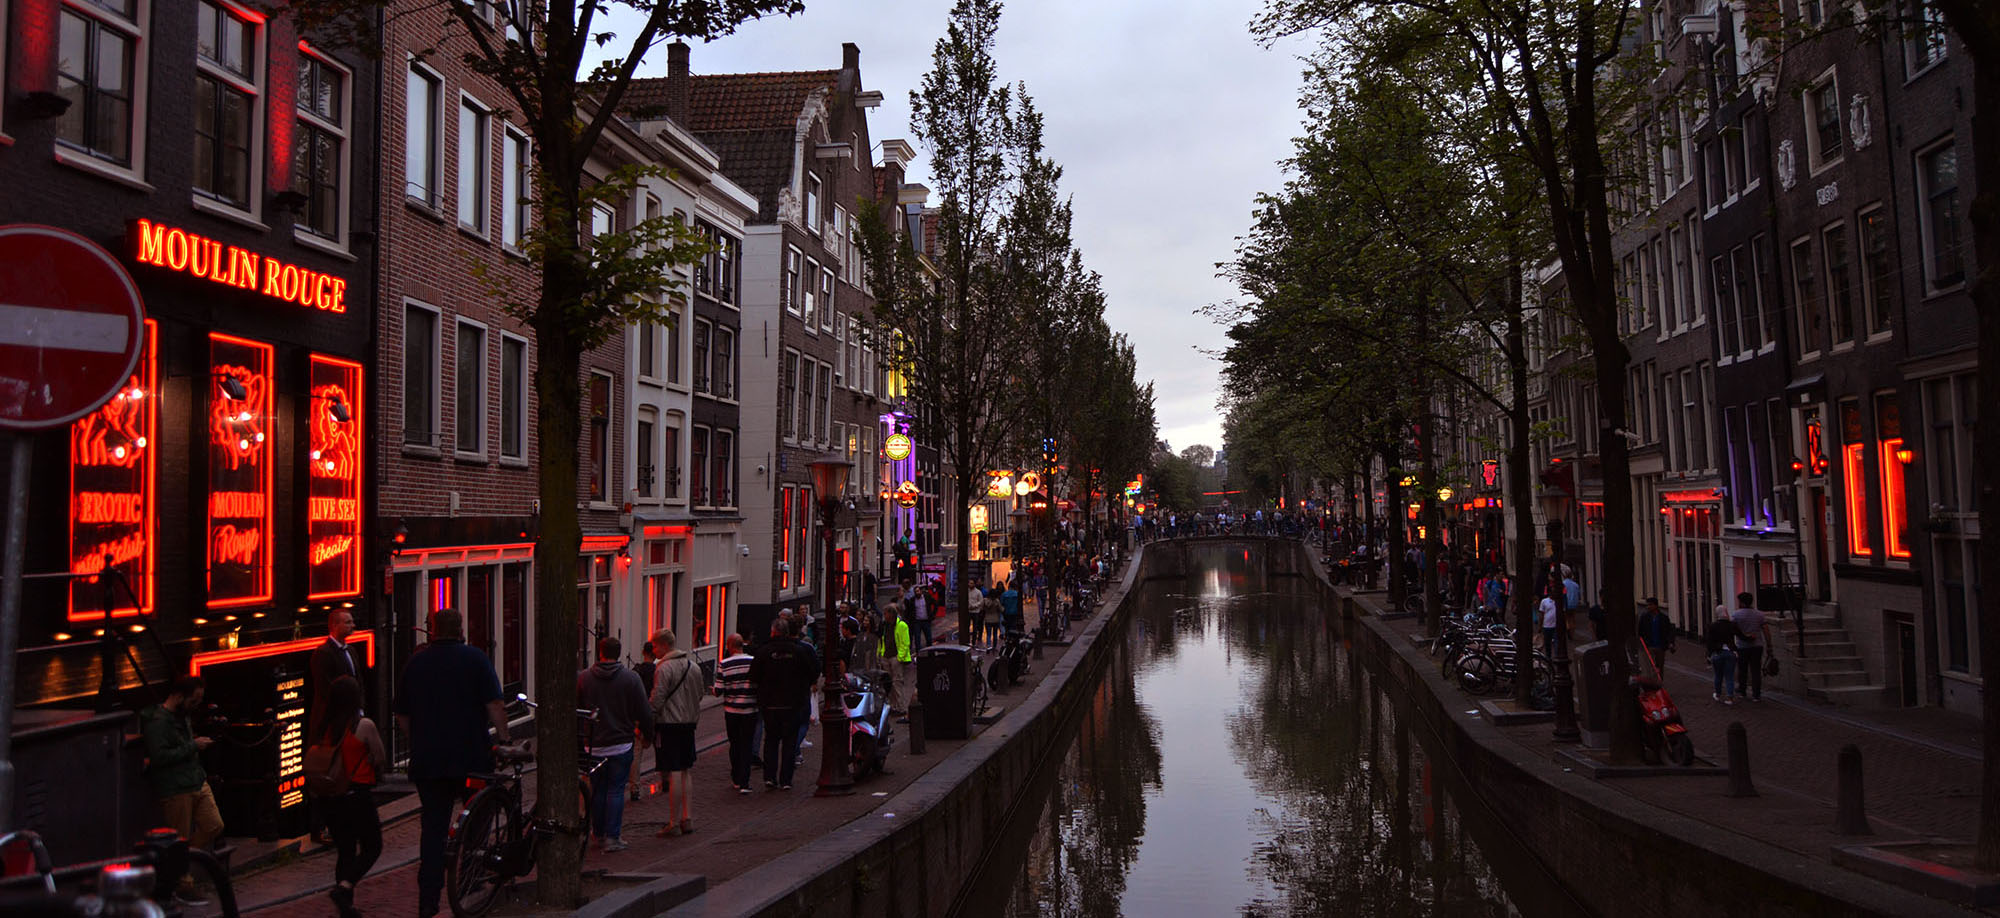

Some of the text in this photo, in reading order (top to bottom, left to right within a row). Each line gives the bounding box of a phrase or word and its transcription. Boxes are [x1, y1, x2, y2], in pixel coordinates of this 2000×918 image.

[138, 218, 347, 313] MOULIN ROUGE
[79, 491, 141, 523] EROTIC
[213, 491, 265, 518] MOULIN
[311, 497, 356, 521] LIVE SEX
[213, 524, 260, 565] Rouge
[314, 536, 353, 566] theater
